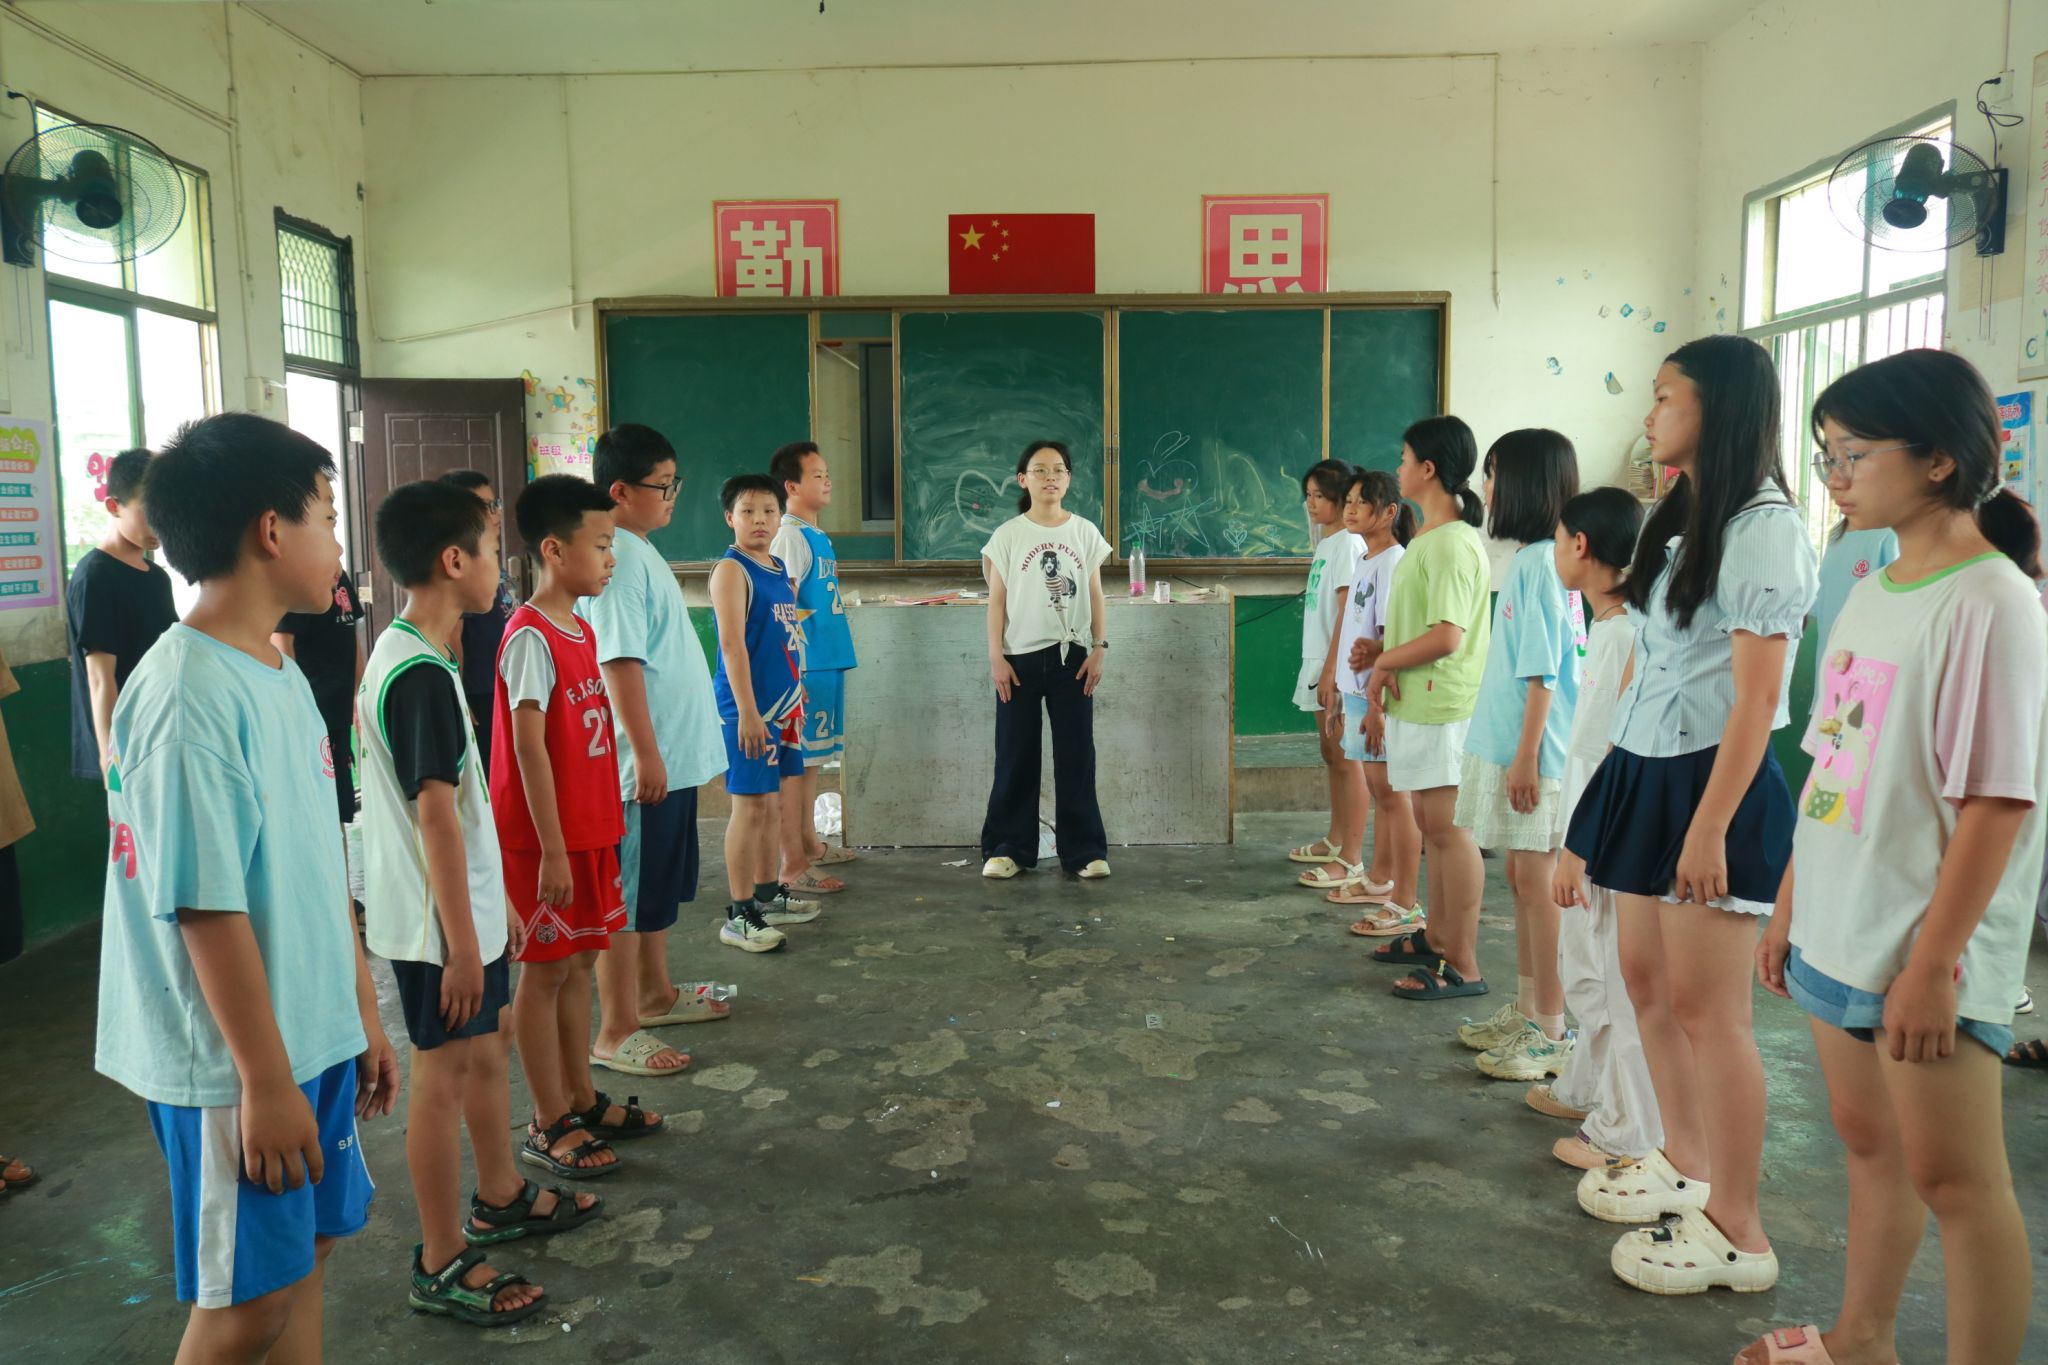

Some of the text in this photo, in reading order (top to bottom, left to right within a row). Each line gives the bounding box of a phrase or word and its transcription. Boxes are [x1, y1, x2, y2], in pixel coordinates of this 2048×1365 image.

[730, 220, 823, 296] 勤
[1223, 213, 1304, 293] 思
[539, 446, 561, 455] 班级
[1021, 542, 1083, 572] MODERN PUPPY
